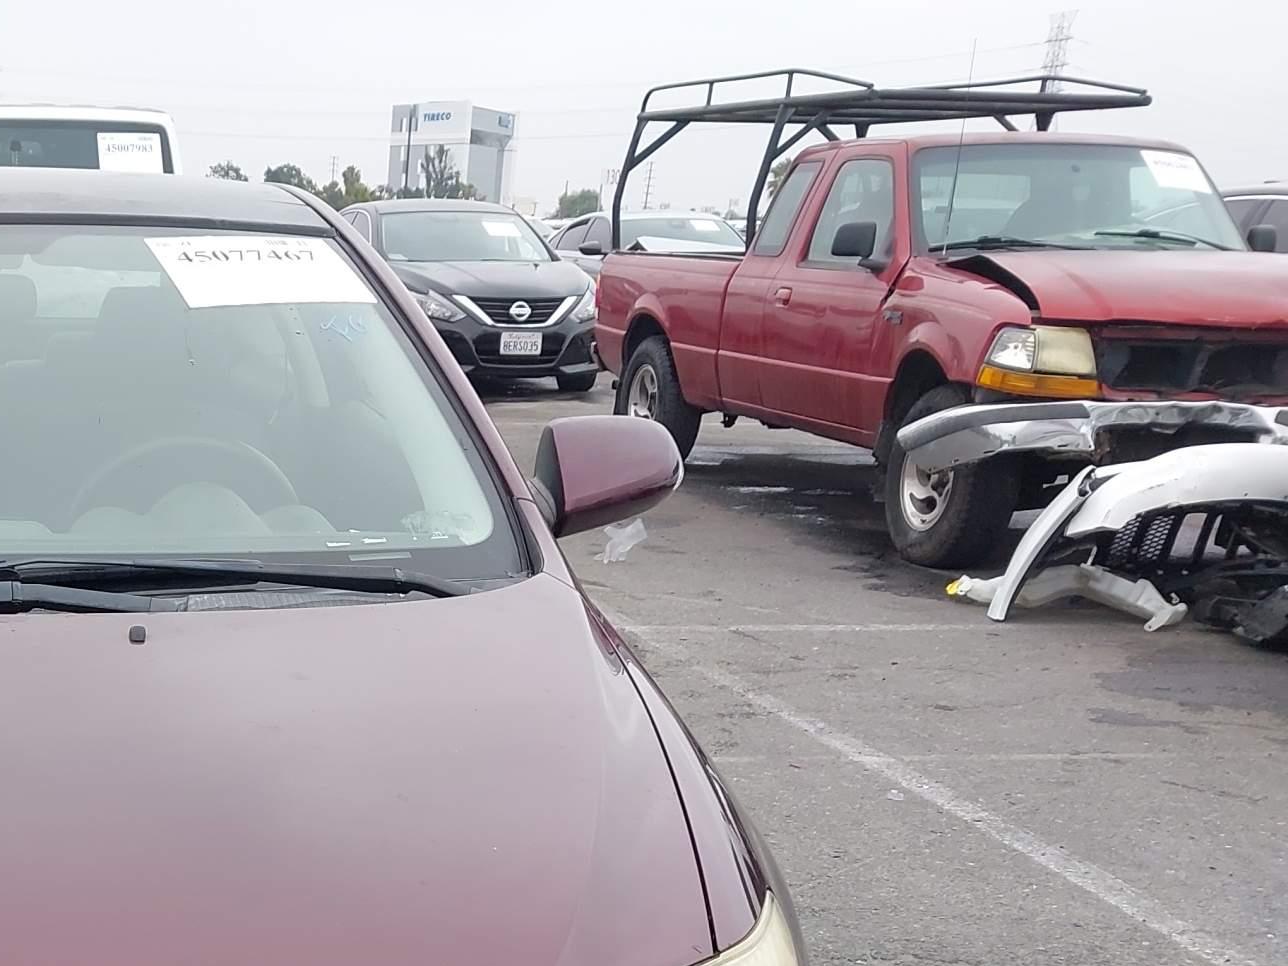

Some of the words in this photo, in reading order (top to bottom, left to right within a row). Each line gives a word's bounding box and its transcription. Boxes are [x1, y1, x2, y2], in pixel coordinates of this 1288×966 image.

[424, 112, 452, 121] TIRECO
[104, 144, 153, 152] 45007983
[178, 250, 314, 262] 45077467
